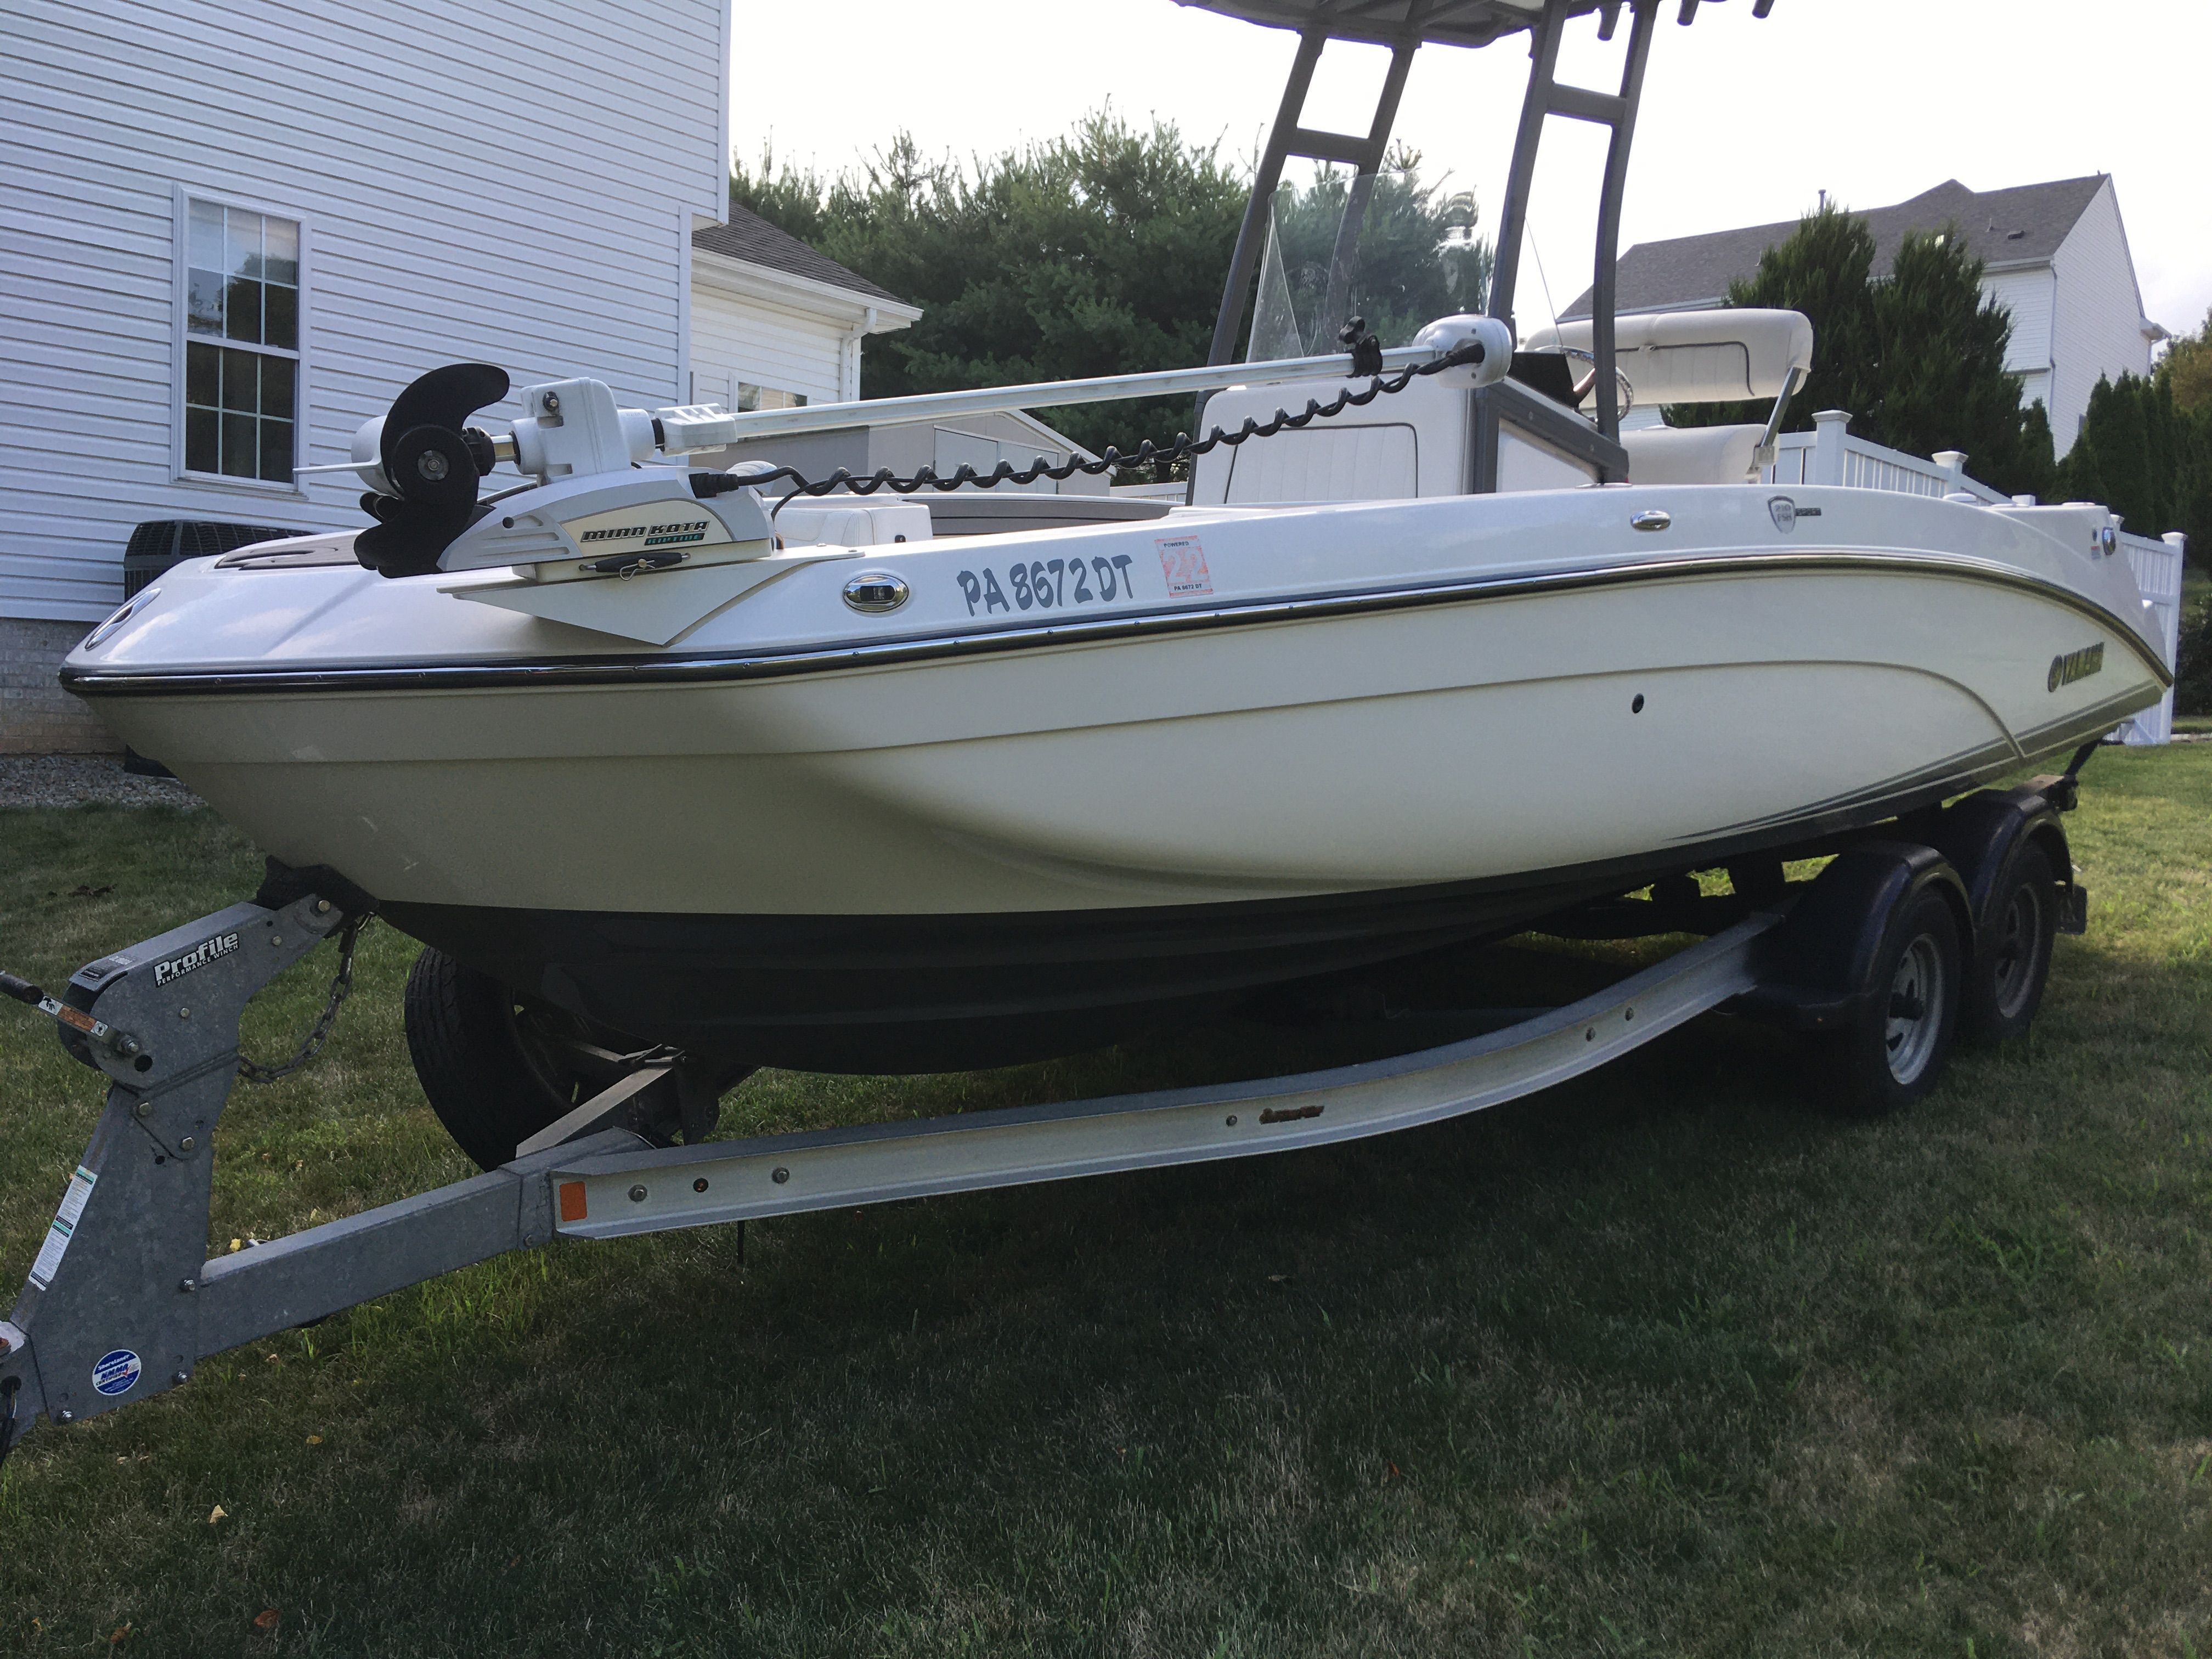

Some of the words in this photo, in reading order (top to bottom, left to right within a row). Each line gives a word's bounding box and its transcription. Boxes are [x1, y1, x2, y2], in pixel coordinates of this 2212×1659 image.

[580, 526, 647, 543] MINN
[647, 521, 710, 537] KOTA
[1163, 549, 1209, 582] 22
[956, 567, 1011, 617] PA
[154, 933, 238, 981] Profile
[157, 956, 211, 986] PERFORMANCE
[213, 944, 238, 959] WINCH
